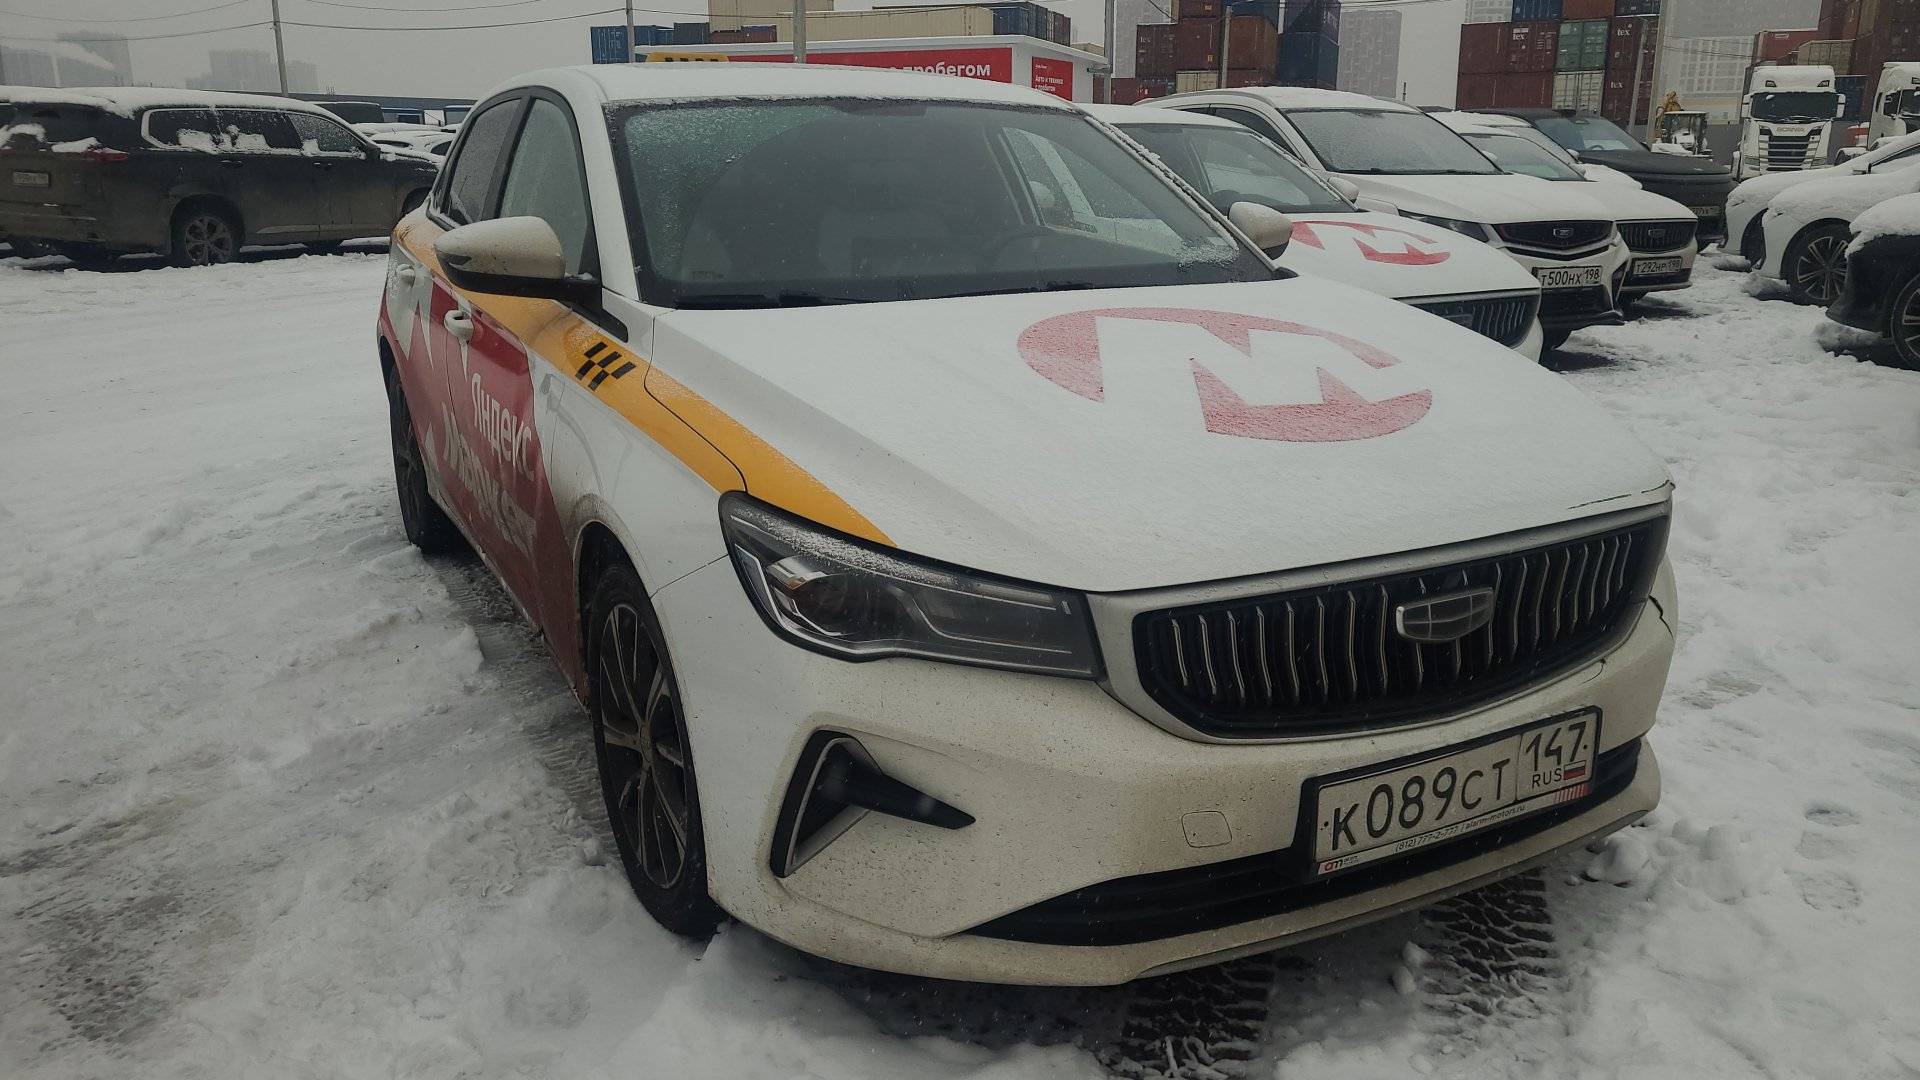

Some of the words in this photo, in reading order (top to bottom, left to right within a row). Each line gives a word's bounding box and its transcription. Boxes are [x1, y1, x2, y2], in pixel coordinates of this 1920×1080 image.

[1584, 268, 1600, 280] 198
[472, 373, 535, 481] Яндекс
[1332, 758, 1511, 850] К089СТ
[1525, 721, 1587, 771] 147
[1531, 768, 1562, 789] RUS
